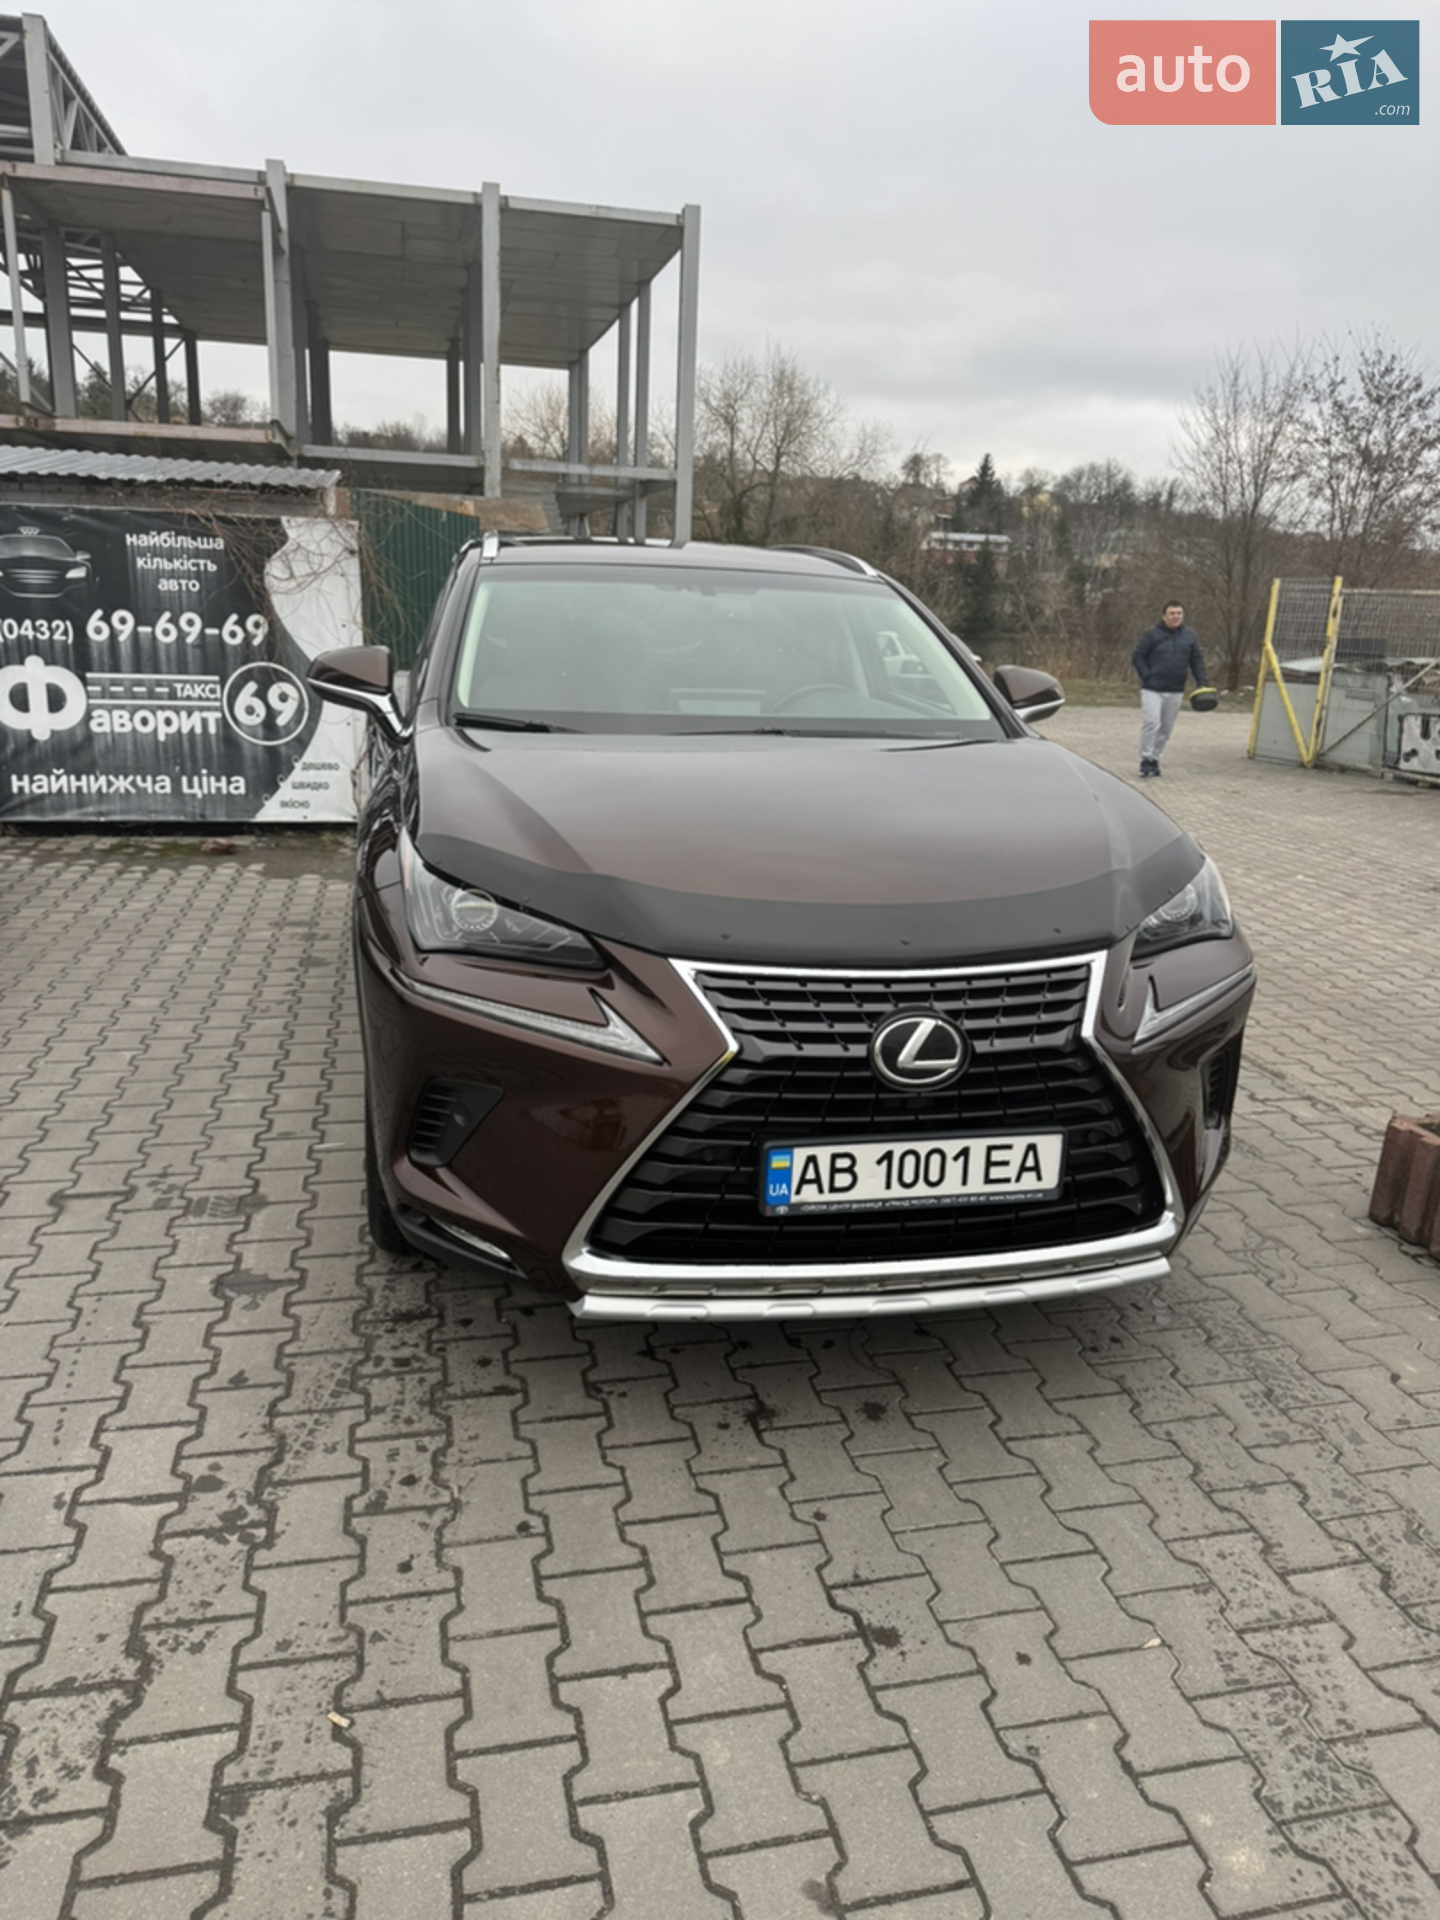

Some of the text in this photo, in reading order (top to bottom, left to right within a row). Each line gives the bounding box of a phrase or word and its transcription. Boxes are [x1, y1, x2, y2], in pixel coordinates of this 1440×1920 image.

[125, 530, 225, 550] найбільша
[136, 553, 218, 572] кількість
[157, 578, 201, 592] авто
[86, 608, 270, 646] 69-69-69
[173, 683, 221, 699] ТАКСІ
[233, 680, 301, 727] 69
[10, 769, 247, 798] найнижча ціна
[794, 1142, 1044, 1196] AB 1001 EA
[769, 1183, 789, 1196] UA
